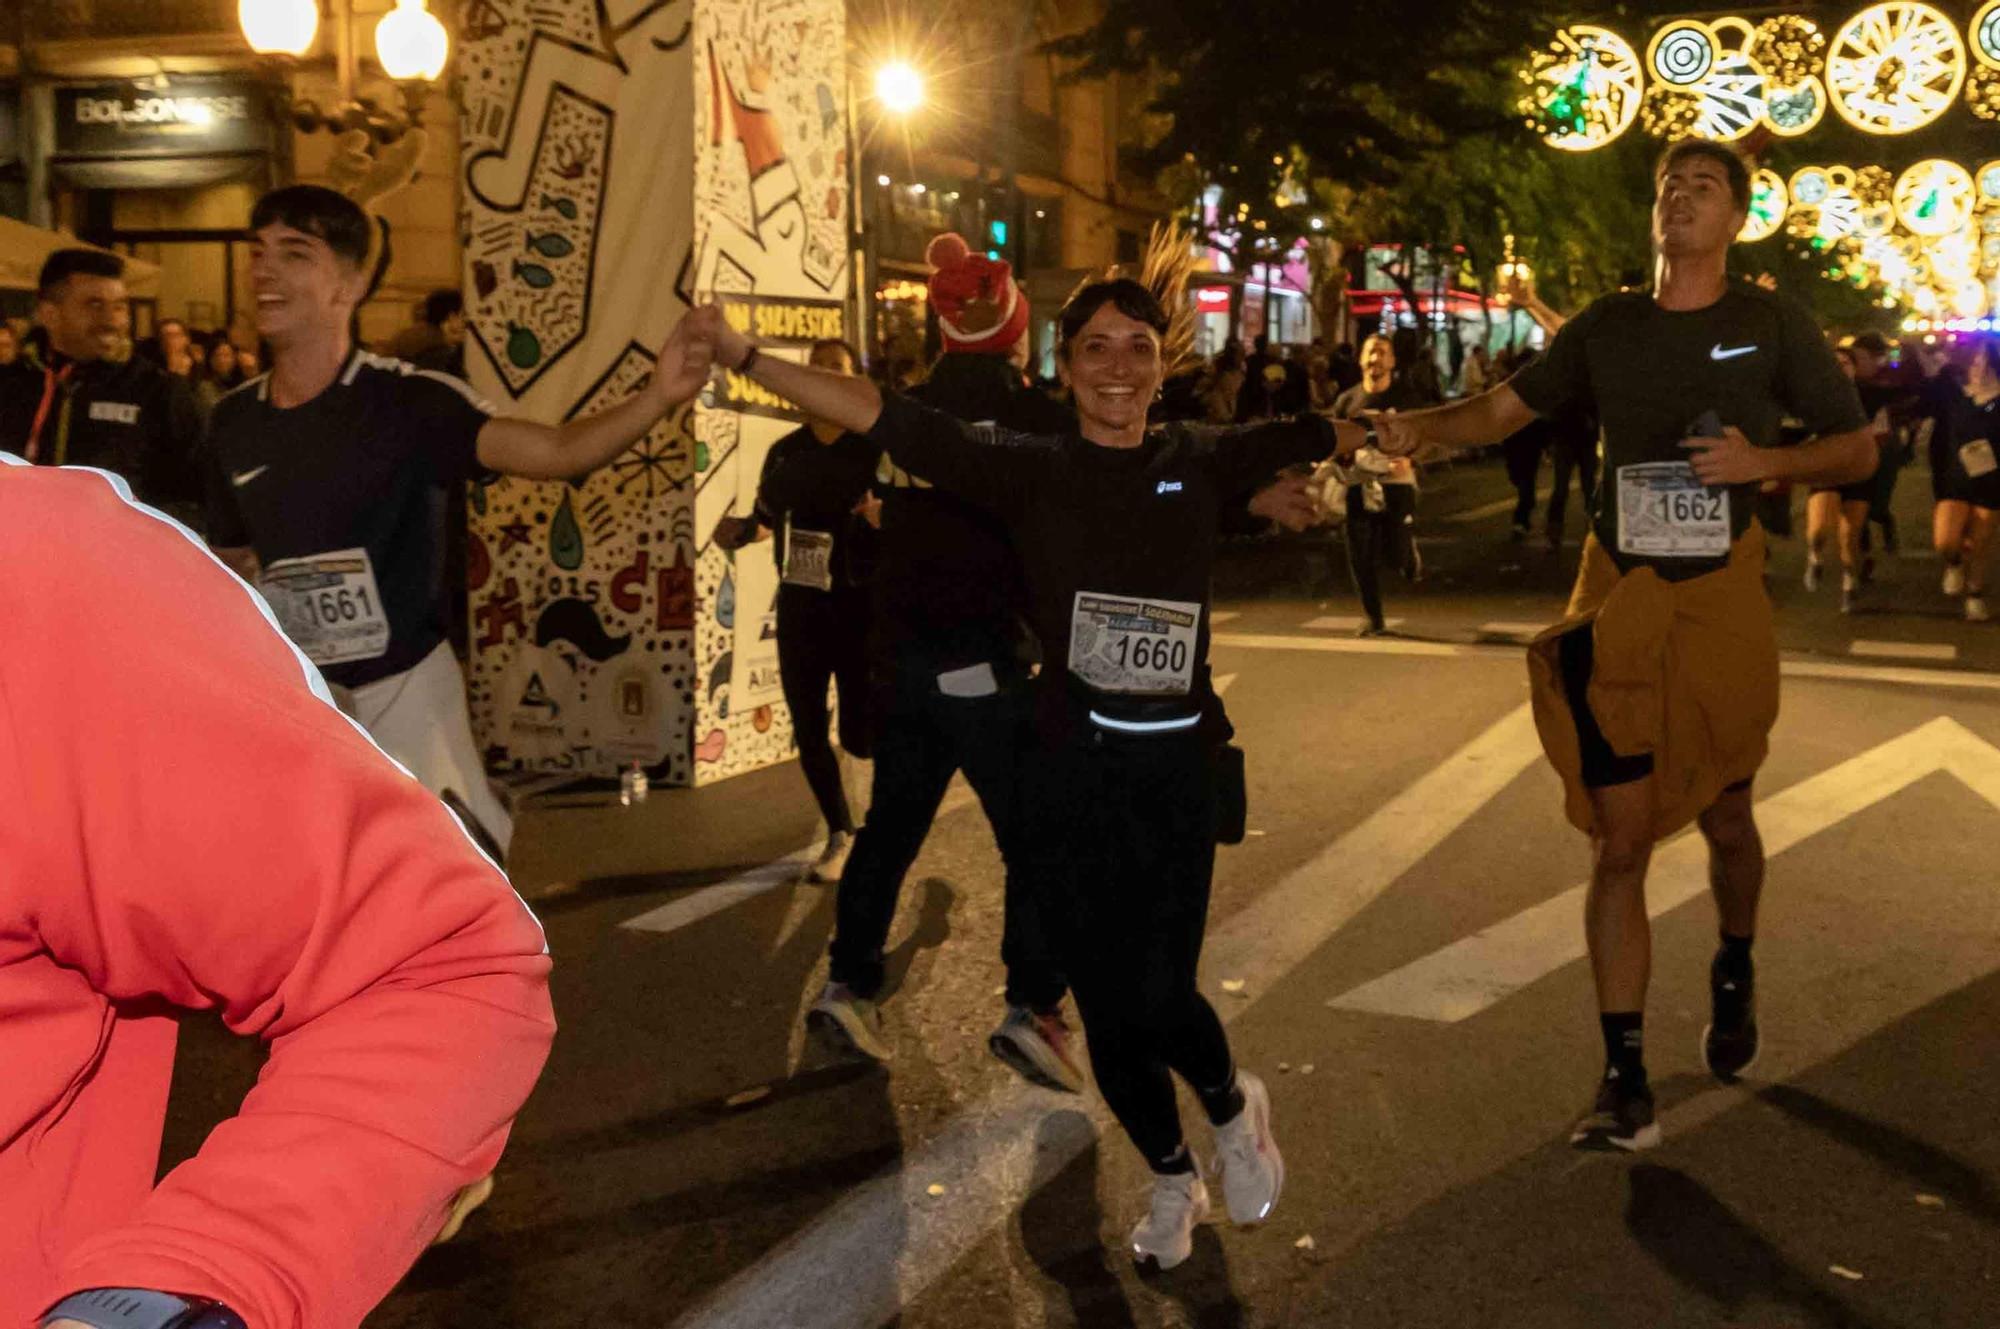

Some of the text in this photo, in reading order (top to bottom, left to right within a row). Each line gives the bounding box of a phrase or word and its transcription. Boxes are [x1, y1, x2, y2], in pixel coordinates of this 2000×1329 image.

[754, 303, 842, 339] SILVESTRE
[1660, 493, 1722, 523] 1662
[305, 585, 373, 625] 1661
[1116, 635, 1187, 673] 1660
